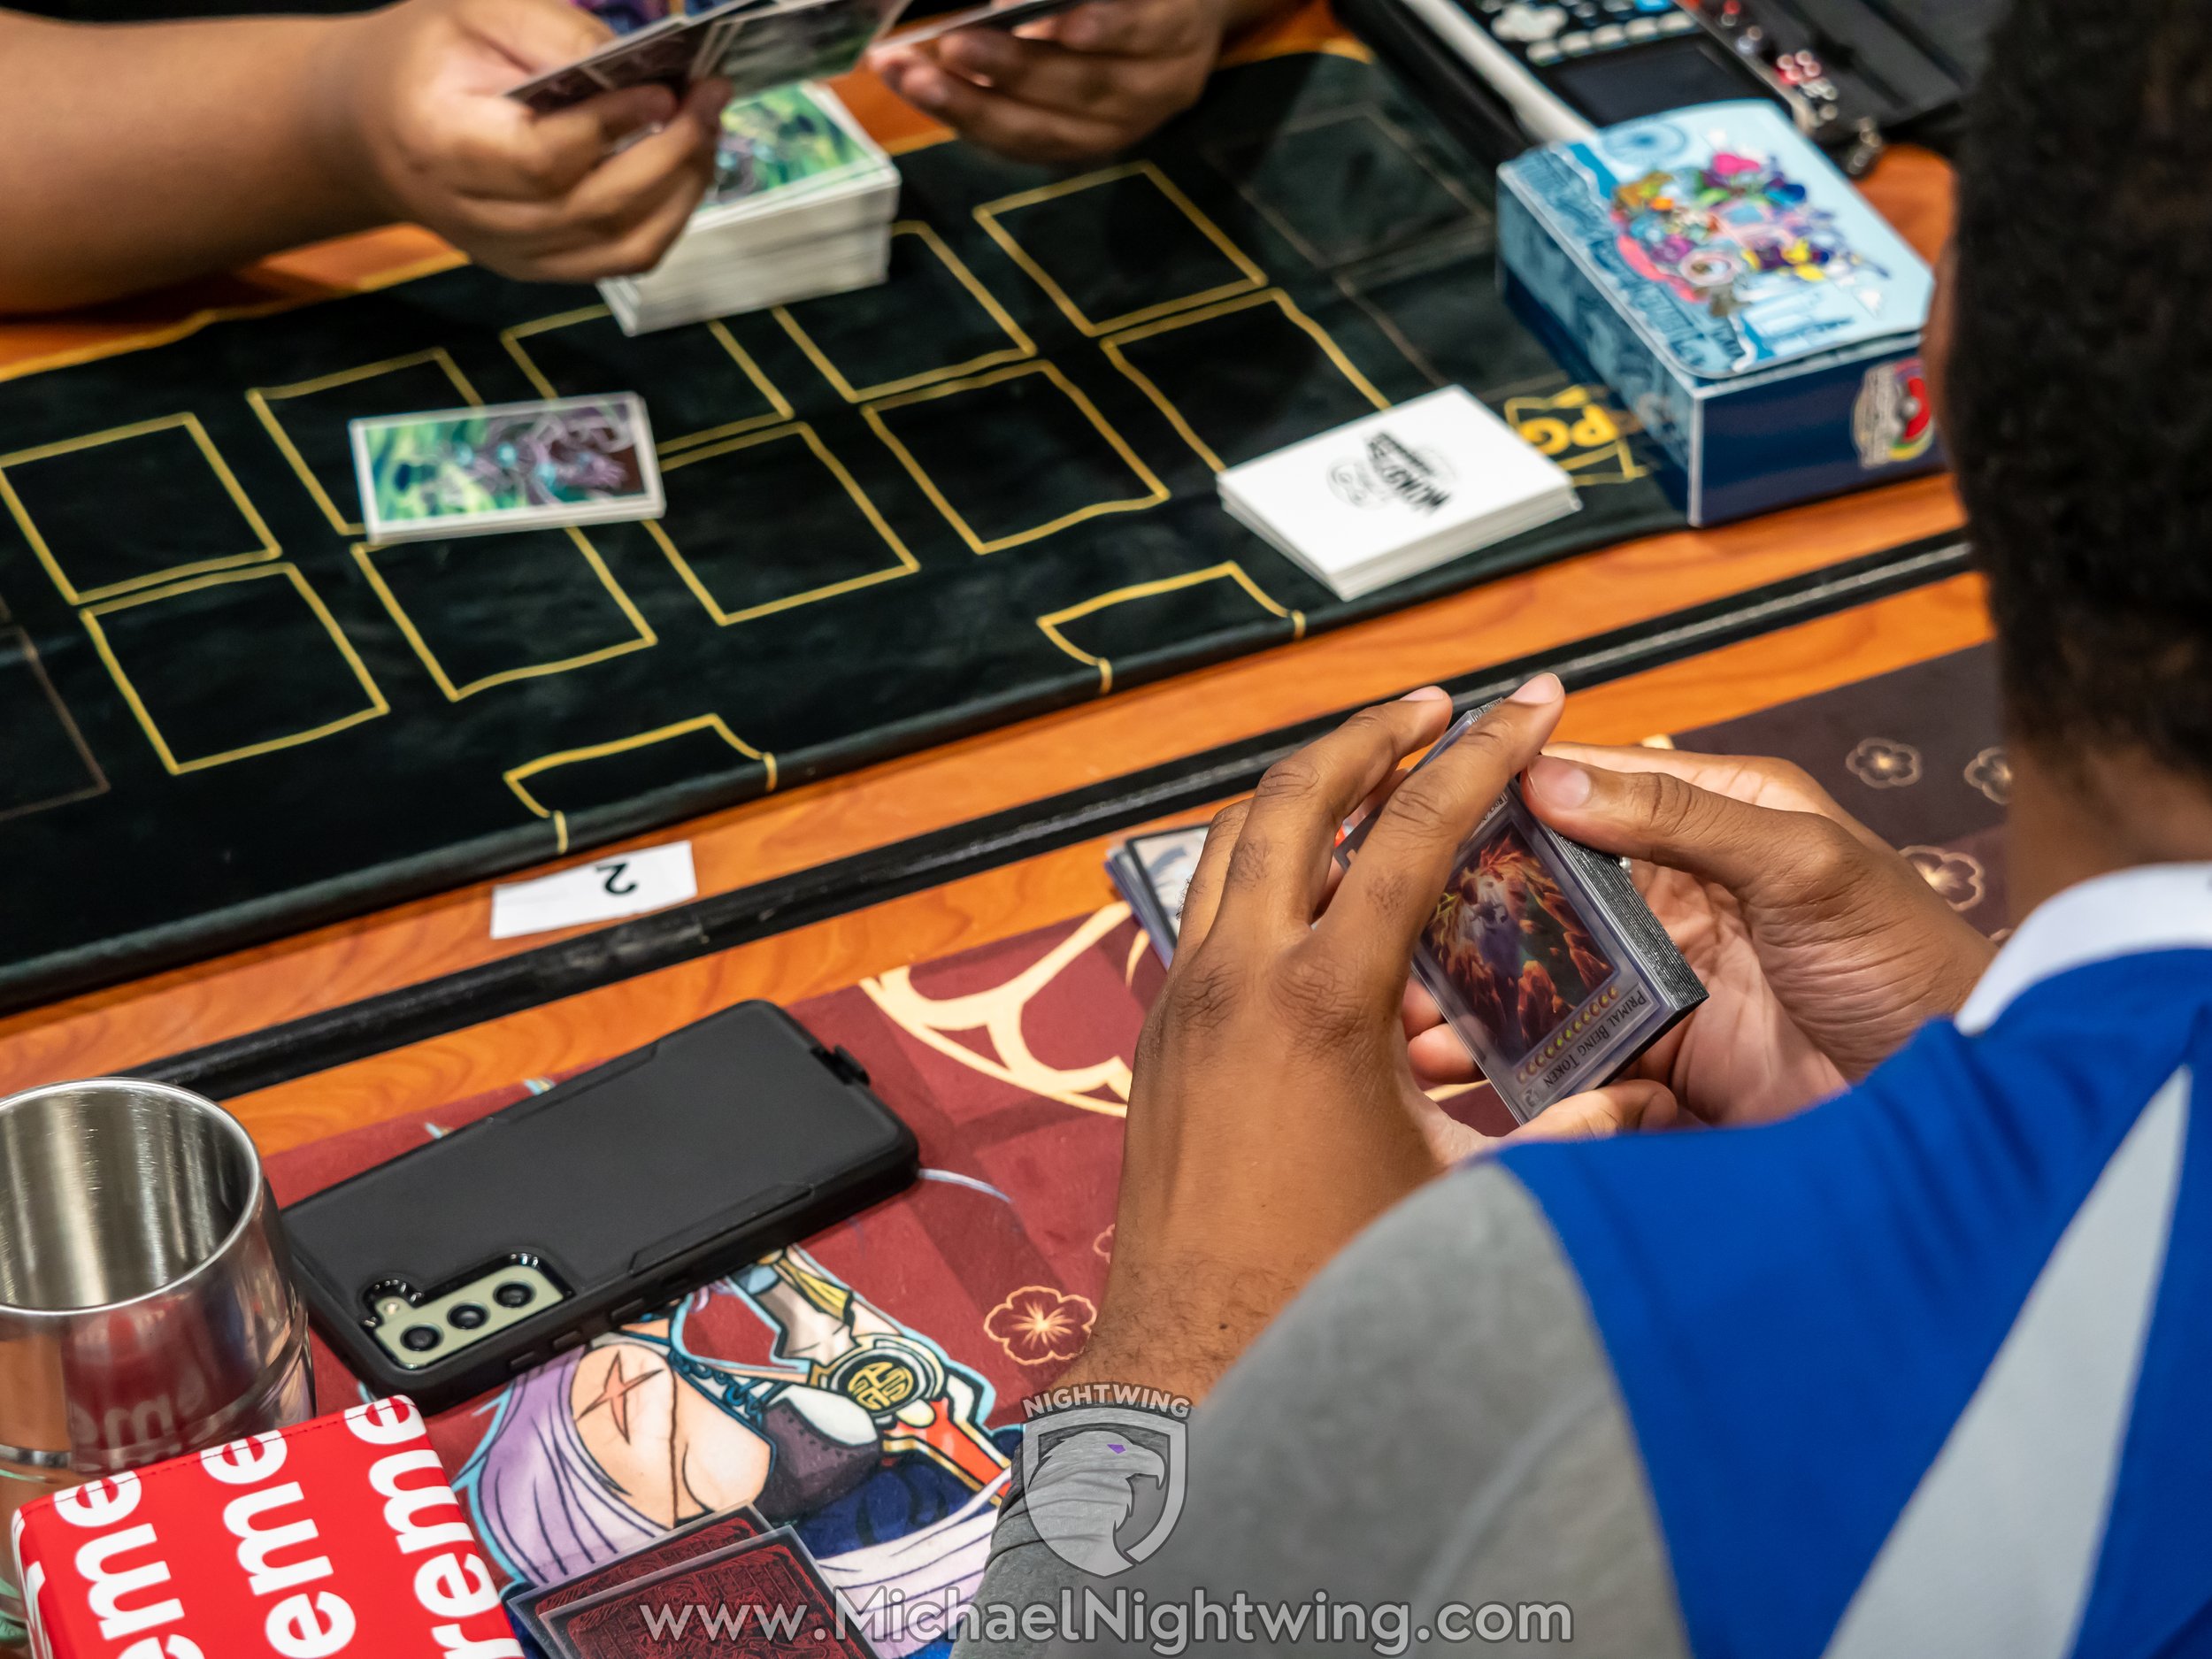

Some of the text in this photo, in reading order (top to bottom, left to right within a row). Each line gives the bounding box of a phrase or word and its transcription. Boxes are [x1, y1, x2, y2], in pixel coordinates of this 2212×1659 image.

[595, 862, 638, 896] 2
[1542, 989, 1647, 1087] PRIMAL BEING TOKEN
